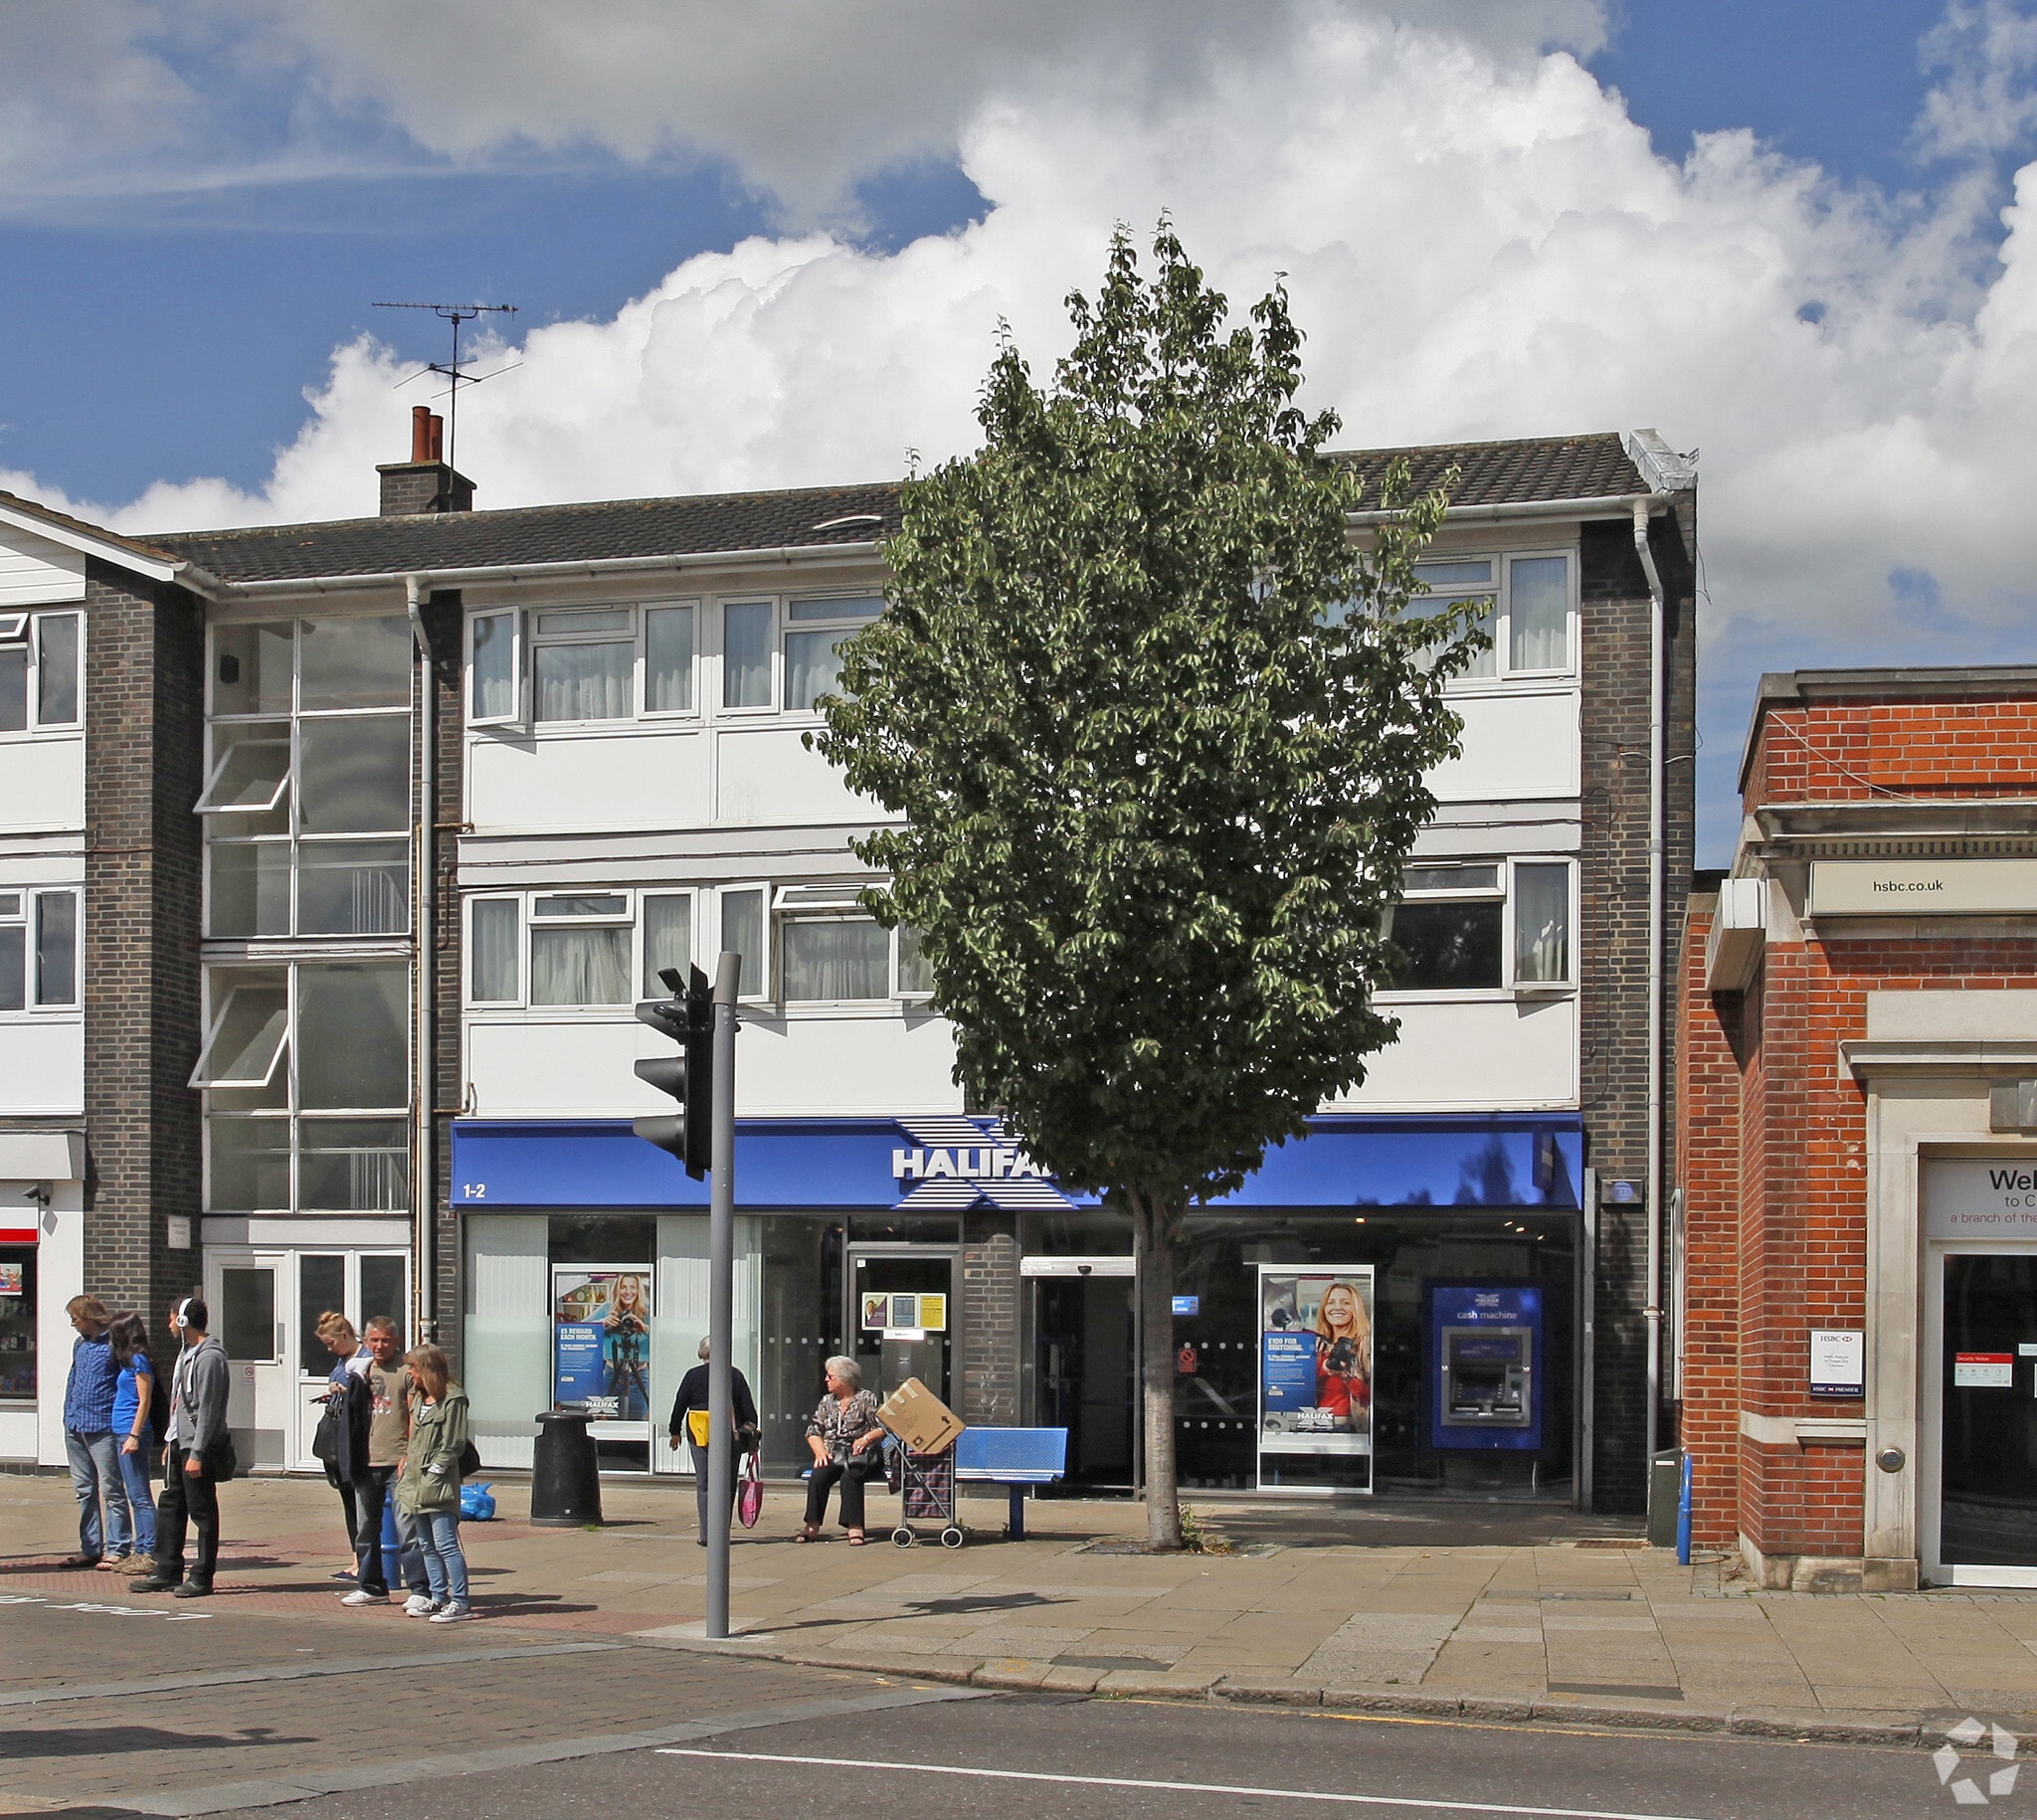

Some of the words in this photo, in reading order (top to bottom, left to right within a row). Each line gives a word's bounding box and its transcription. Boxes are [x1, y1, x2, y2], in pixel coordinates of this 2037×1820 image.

[1873, 879, 1944, 892] hsbc.co.uk
[892, 1149, 1053, 1178] HALIFA
[463, 1183, 486, 1198] 1-2
[2005, 1196, 2020, 1207] to
[1950, 1214, 1957, 1223] a
[1961, 1212, 2001, 1223] branch
[2004, 1212, 2017, 1223] of
[1457, 1310, 1478, 1320] cash
[1480, 1310, 1518, 1320] machine
